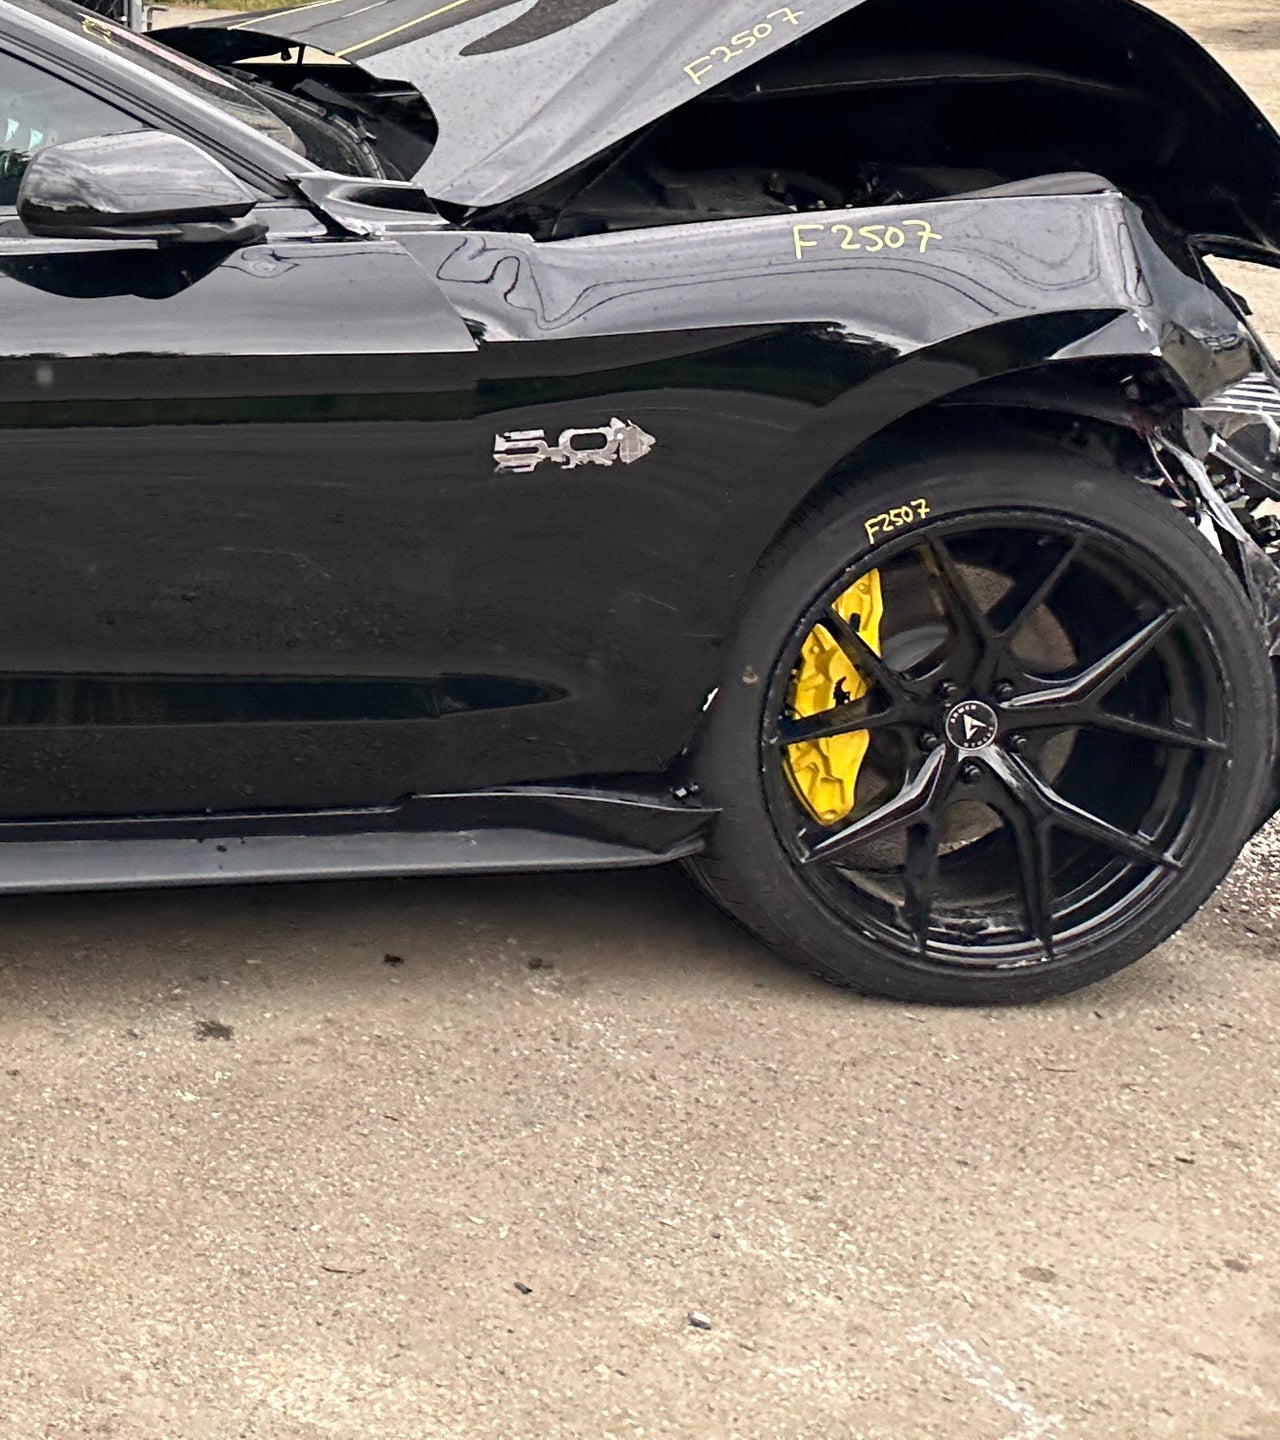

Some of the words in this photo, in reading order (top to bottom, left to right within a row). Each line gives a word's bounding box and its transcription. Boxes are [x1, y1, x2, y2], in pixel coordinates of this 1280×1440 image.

[683, 6, 805, 85] F2507
[792, 219, 943, 260] F2507
[864, 498, 931, 545] F2507
